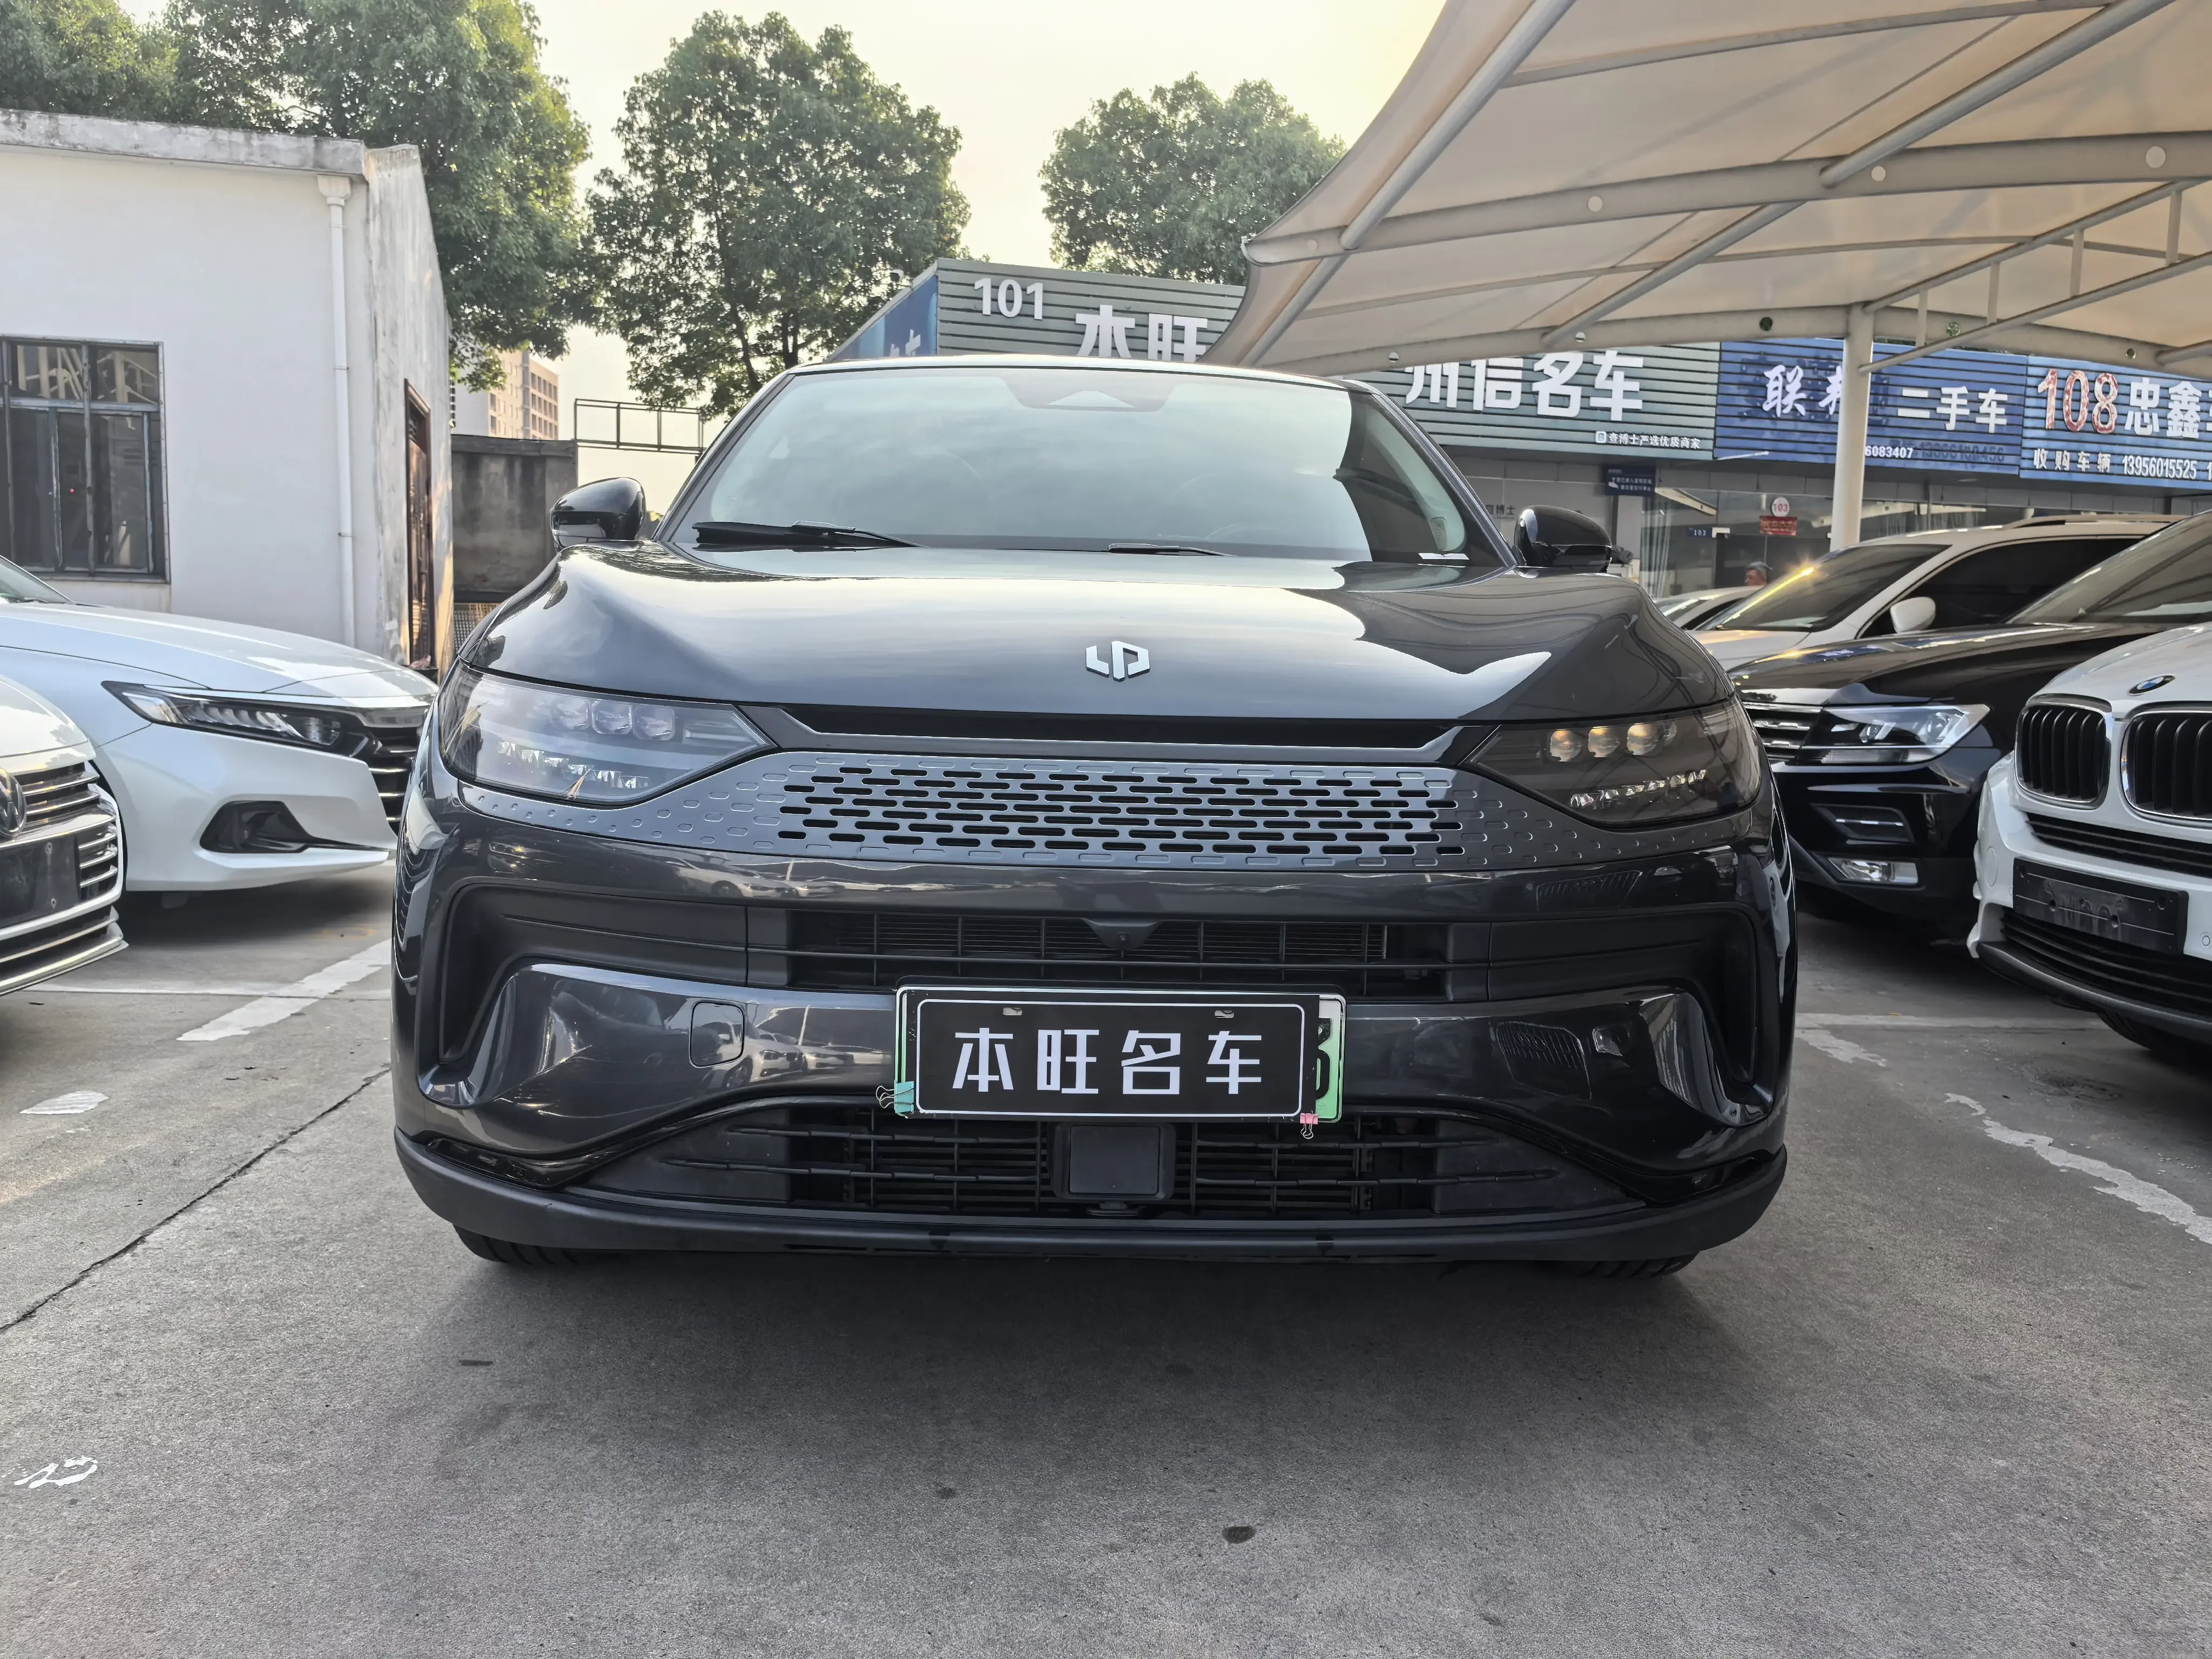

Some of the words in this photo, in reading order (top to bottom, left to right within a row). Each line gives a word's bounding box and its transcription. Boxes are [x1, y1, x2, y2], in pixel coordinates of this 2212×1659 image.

[974, 278, 1043, 320] 101
[1898, 386, 2008, 434] 二手车
[2038, 369, 2119, 434] 108
[2124, 377, 2212, 439] 忠鑫
[1608, 433, 1700, 449] 查博士严选优质商家
[2033, 448, 2111, 473] 收购车辆
[2122, 455, 2197, 480] 13956015525
[1773, 503, 1788, 512] 103
[952, 1027, 1262, 1095] 本旺名车
